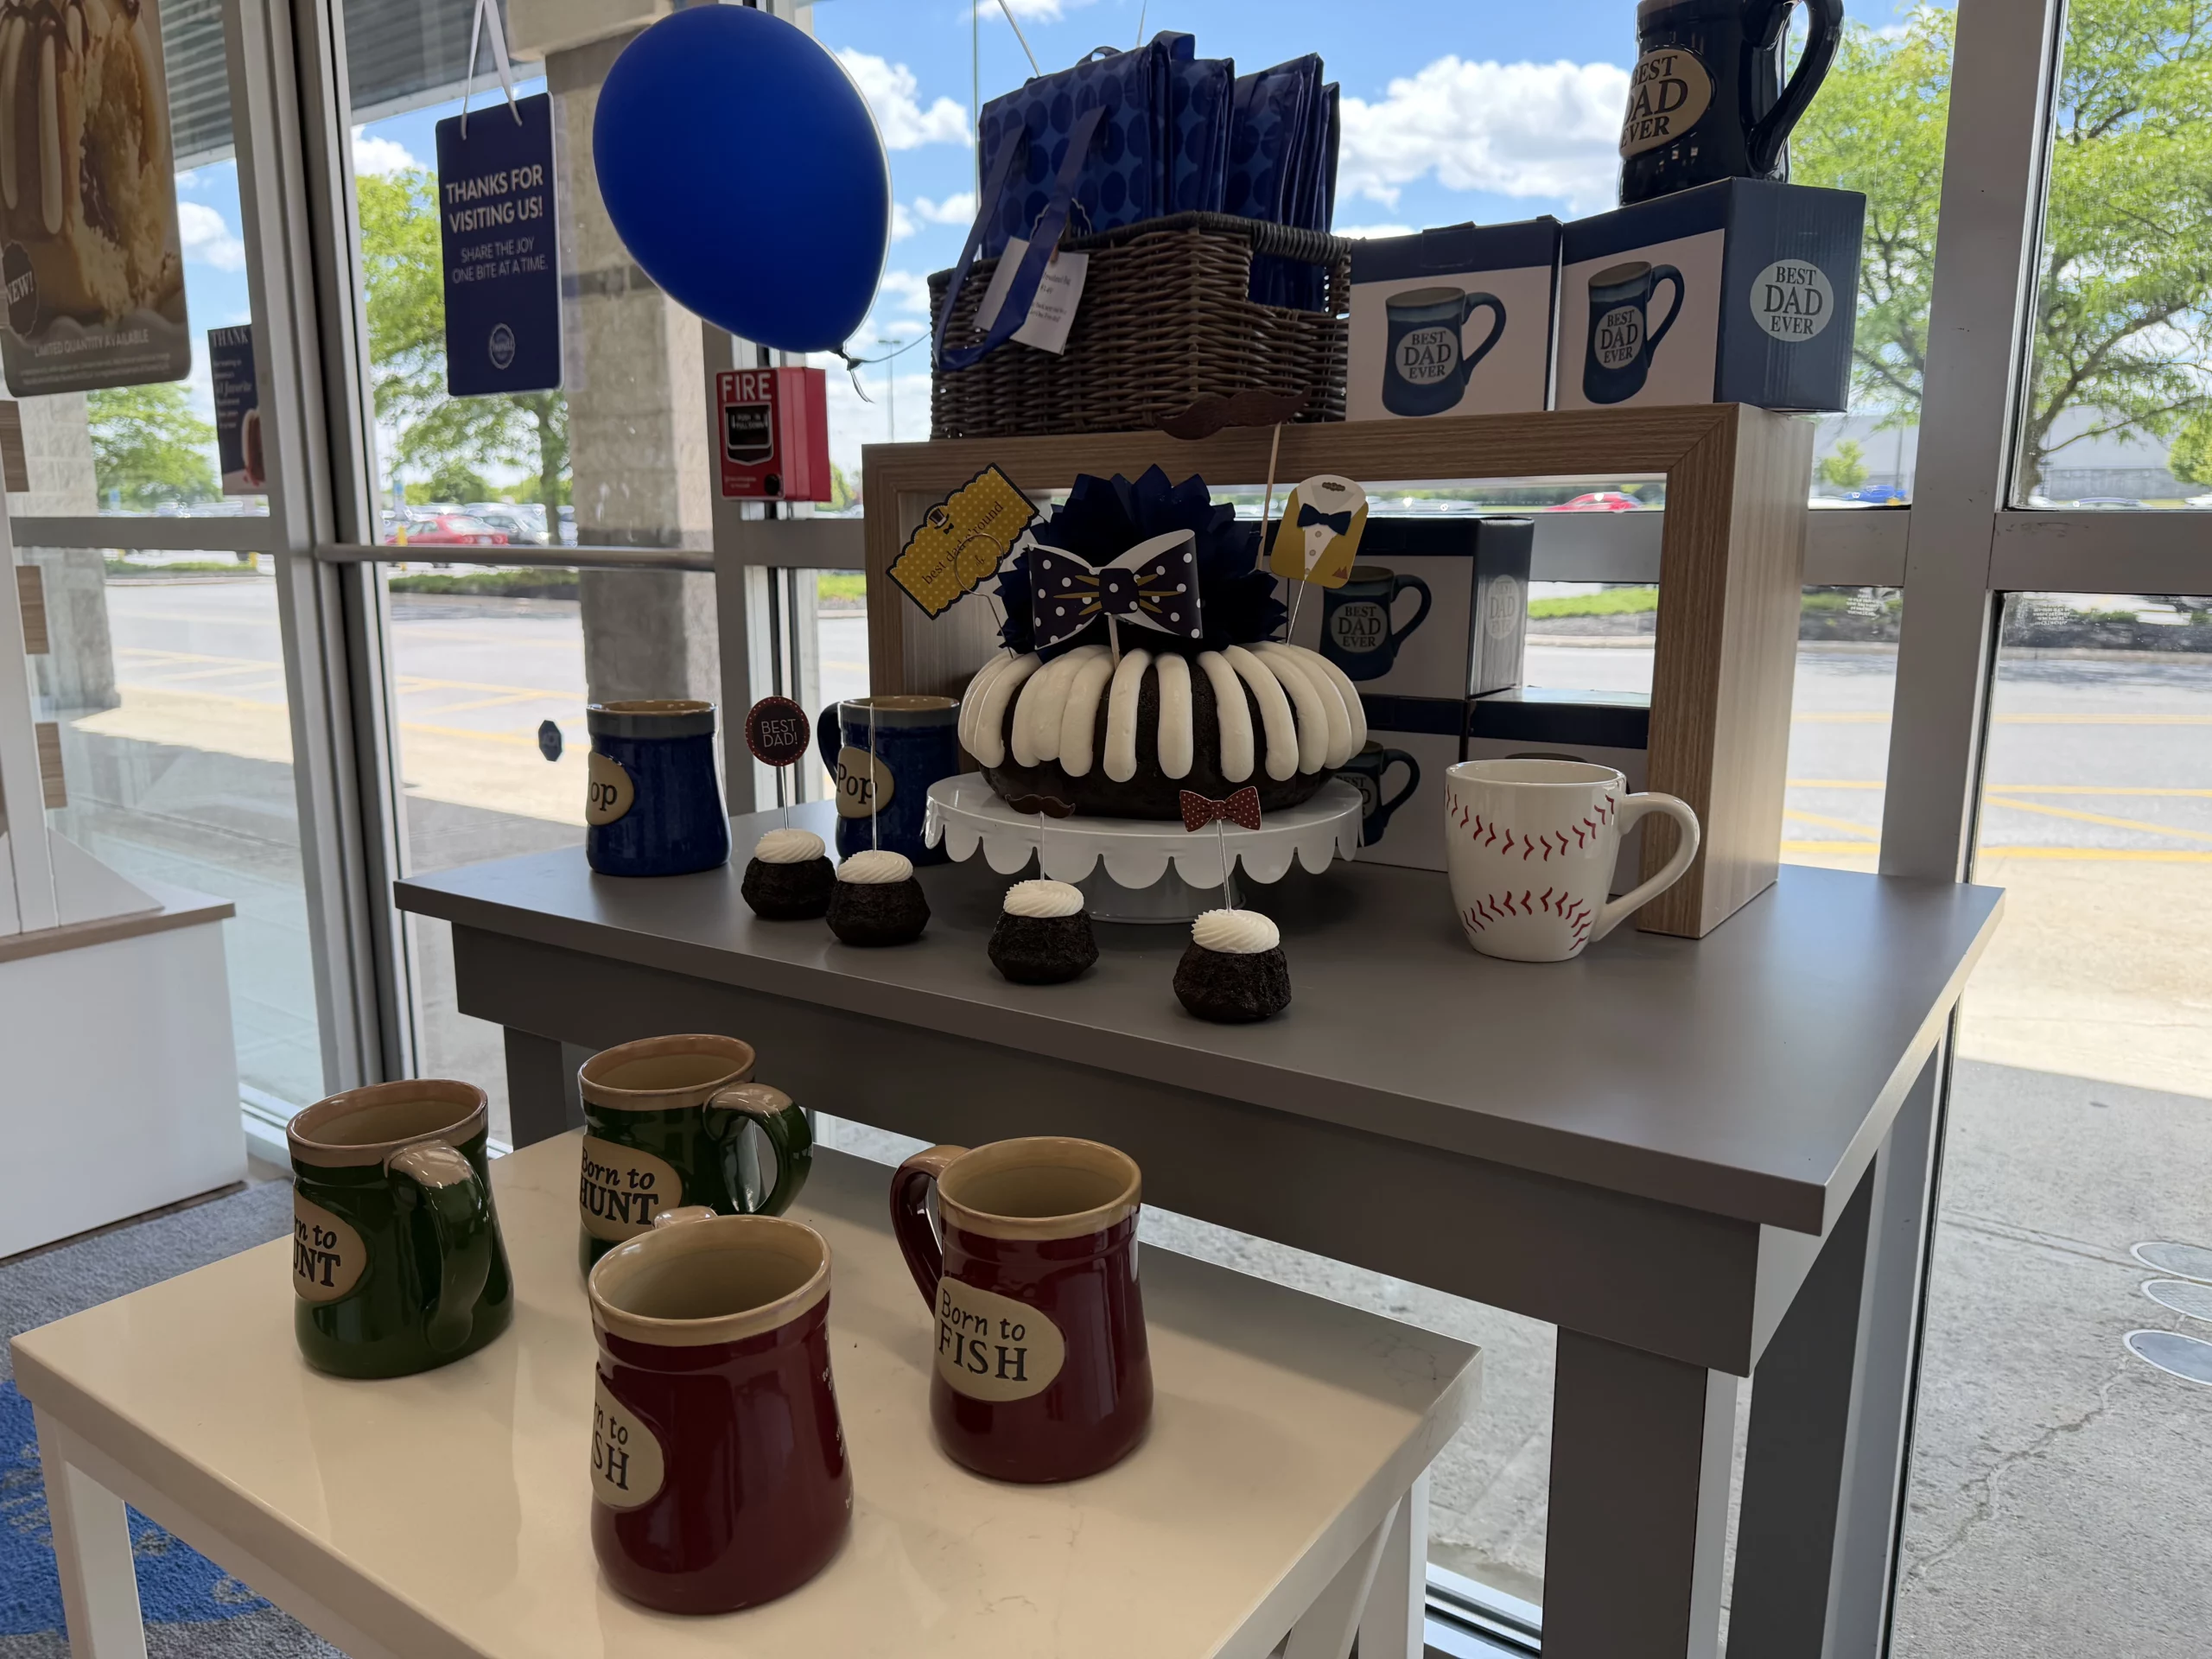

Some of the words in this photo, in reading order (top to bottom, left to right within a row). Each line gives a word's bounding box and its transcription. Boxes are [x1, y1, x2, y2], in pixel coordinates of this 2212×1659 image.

[1620, 116, 1669, 149] EVER
[446, 171, 509, 204] THANKS
[512, 163, 543, 191] FOR
[449, 201, 515, 233] VISITING
[518, 195, 543, 220] US!
[461, 243, 493, 263] SHARE
[494, 239, 514, 256] THE
[517, 236, 534, 254] JOY
[452, 265, 474, 283] ONE
[476, 262, 497, 280] BITE
[499, 259, 511, 276] AT
[512, 259, 520, 274] A
[1776, 266, 1816, 286] BEST
[7, 270, 34, 306] NEW!
[1764, 284, 1823, 316] DAD
[1607, 308, 1635, 327] BEST
[1770, 315, 1814, 335] EVER
[35, 340, 63, 358] LIMITED
[64, 336, 103, 353] QUANTITY
[105, 328, 149, 348] AVAILABLE
[1412, 330, 1446, 346] BEST
[1600, 323, 1638, 350] DAD
[1403, 344, 1452, 366] DAD
[1604, 346, 1632, 364] EVER
[1409, 364, 1446, 379] EVER
[721, 372, 772, 401] FIRE
[922, 561, 946, 585] best
[945, 539, 966, 563] dad
[1344, 606, 1376, 618] BEST
[1490, 594, 1516, 619] DAD
[1338, 616, 1381, 636] DAD
[1343, 635, 1376, 647] EVER
[761, 718, 797, 734] BEST
[763, 732, 798, 747] DAD!
[591, 781, 618, 812] op
[836, 762, 879, 804] Pop
[582, 1146, 620, 1186] Born
[626, 1168, 656, 1191] to
[580, 1173, 659, 1225] HUNT
[312, 1224, 337, 1249] to
[294, 1238, 341, 1288] UNT
[942, 1287, 988, 1337] Born
[1000, 1318, 1026, 1342] to
[938, 1319, 1028, 1382] FISH
[609, 1416, 628, 1446] to
[594, 1430, 630, 1491] SH
